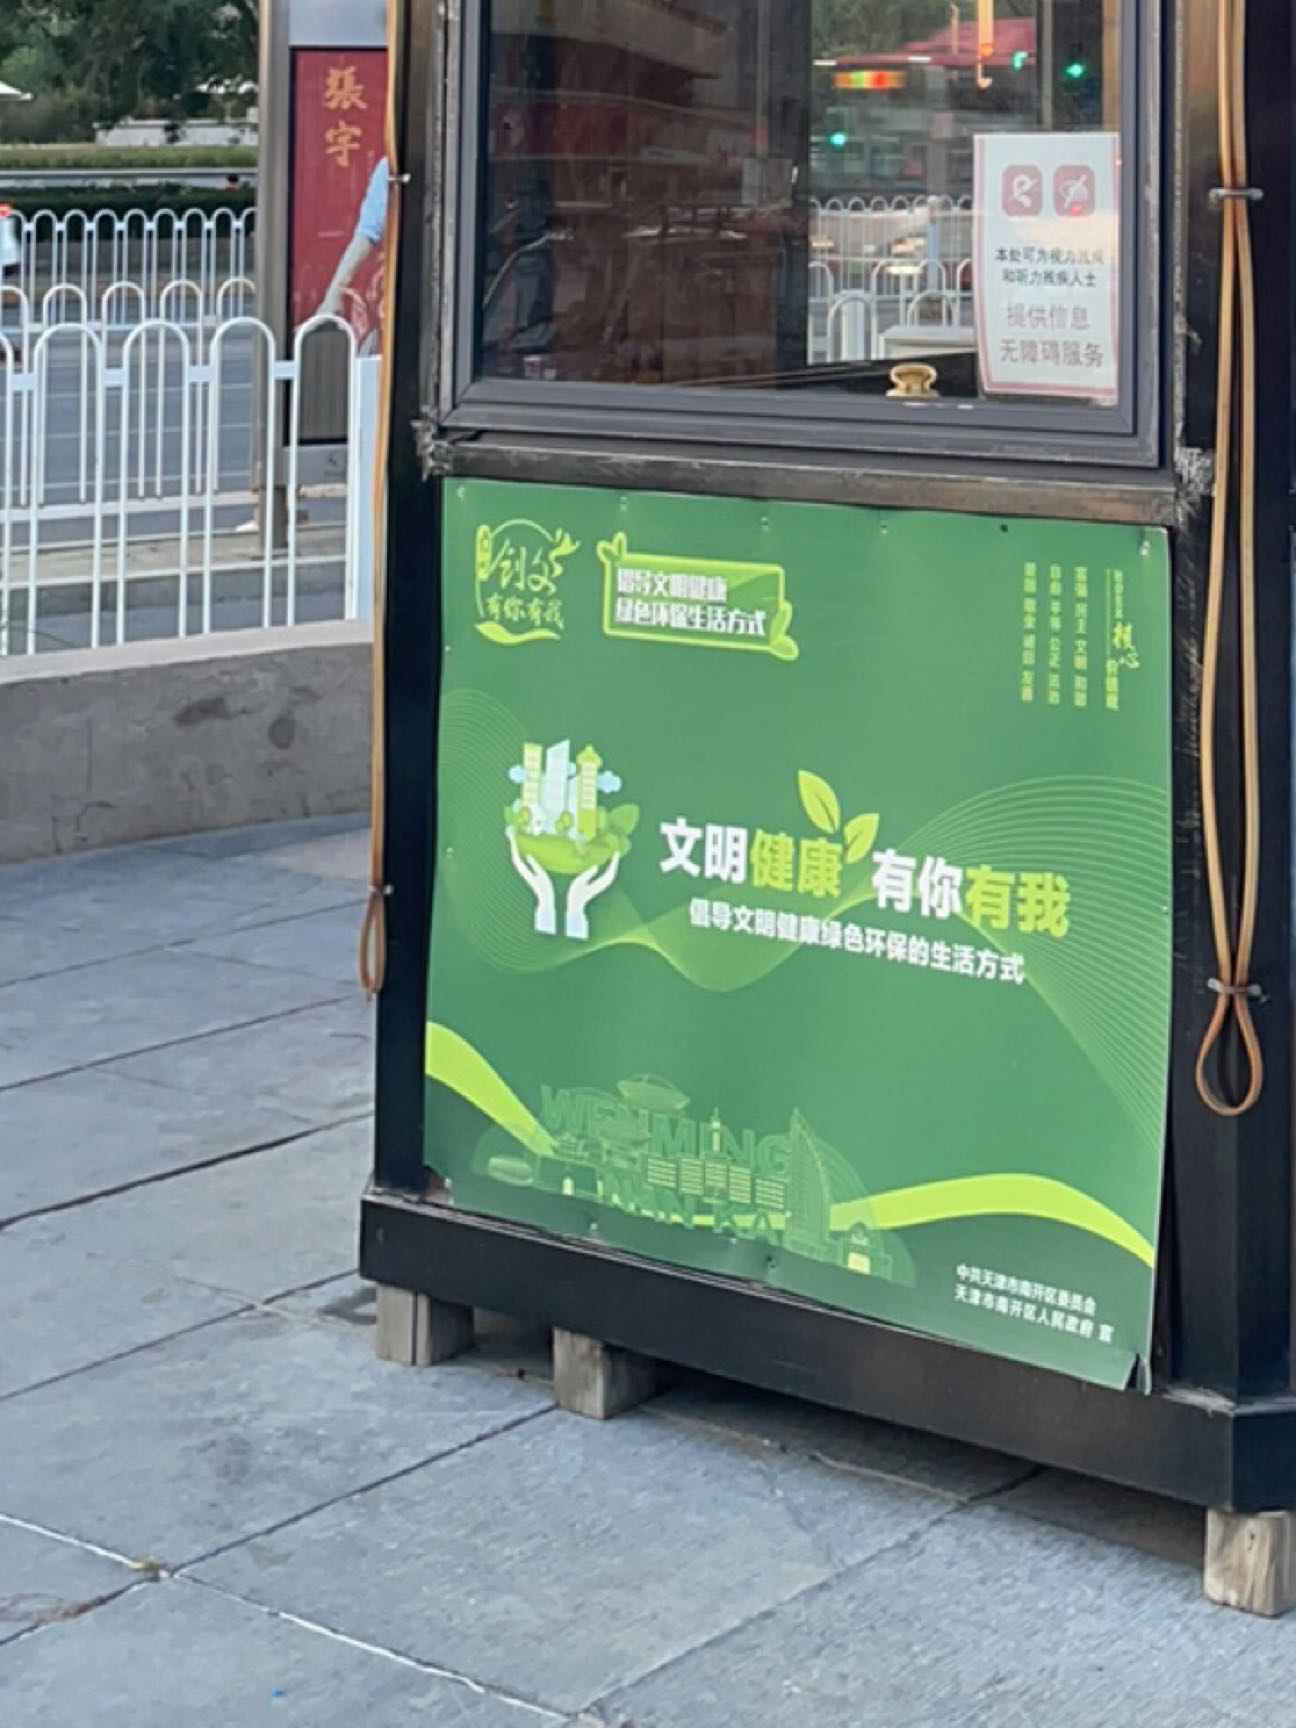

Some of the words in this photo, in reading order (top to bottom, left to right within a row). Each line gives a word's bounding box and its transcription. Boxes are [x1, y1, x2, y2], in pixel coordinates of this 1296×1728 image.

[1006, 302, 1091, 331] 提供信息
[999, 338, 1104, 368] 无障碍服务
[659, 816, 843, 900] 文明健康
[871, 847, 1072, 939] 有你有我
[689, 898, 1027, 985] 倡导文明健康绿色环保的生活方式
